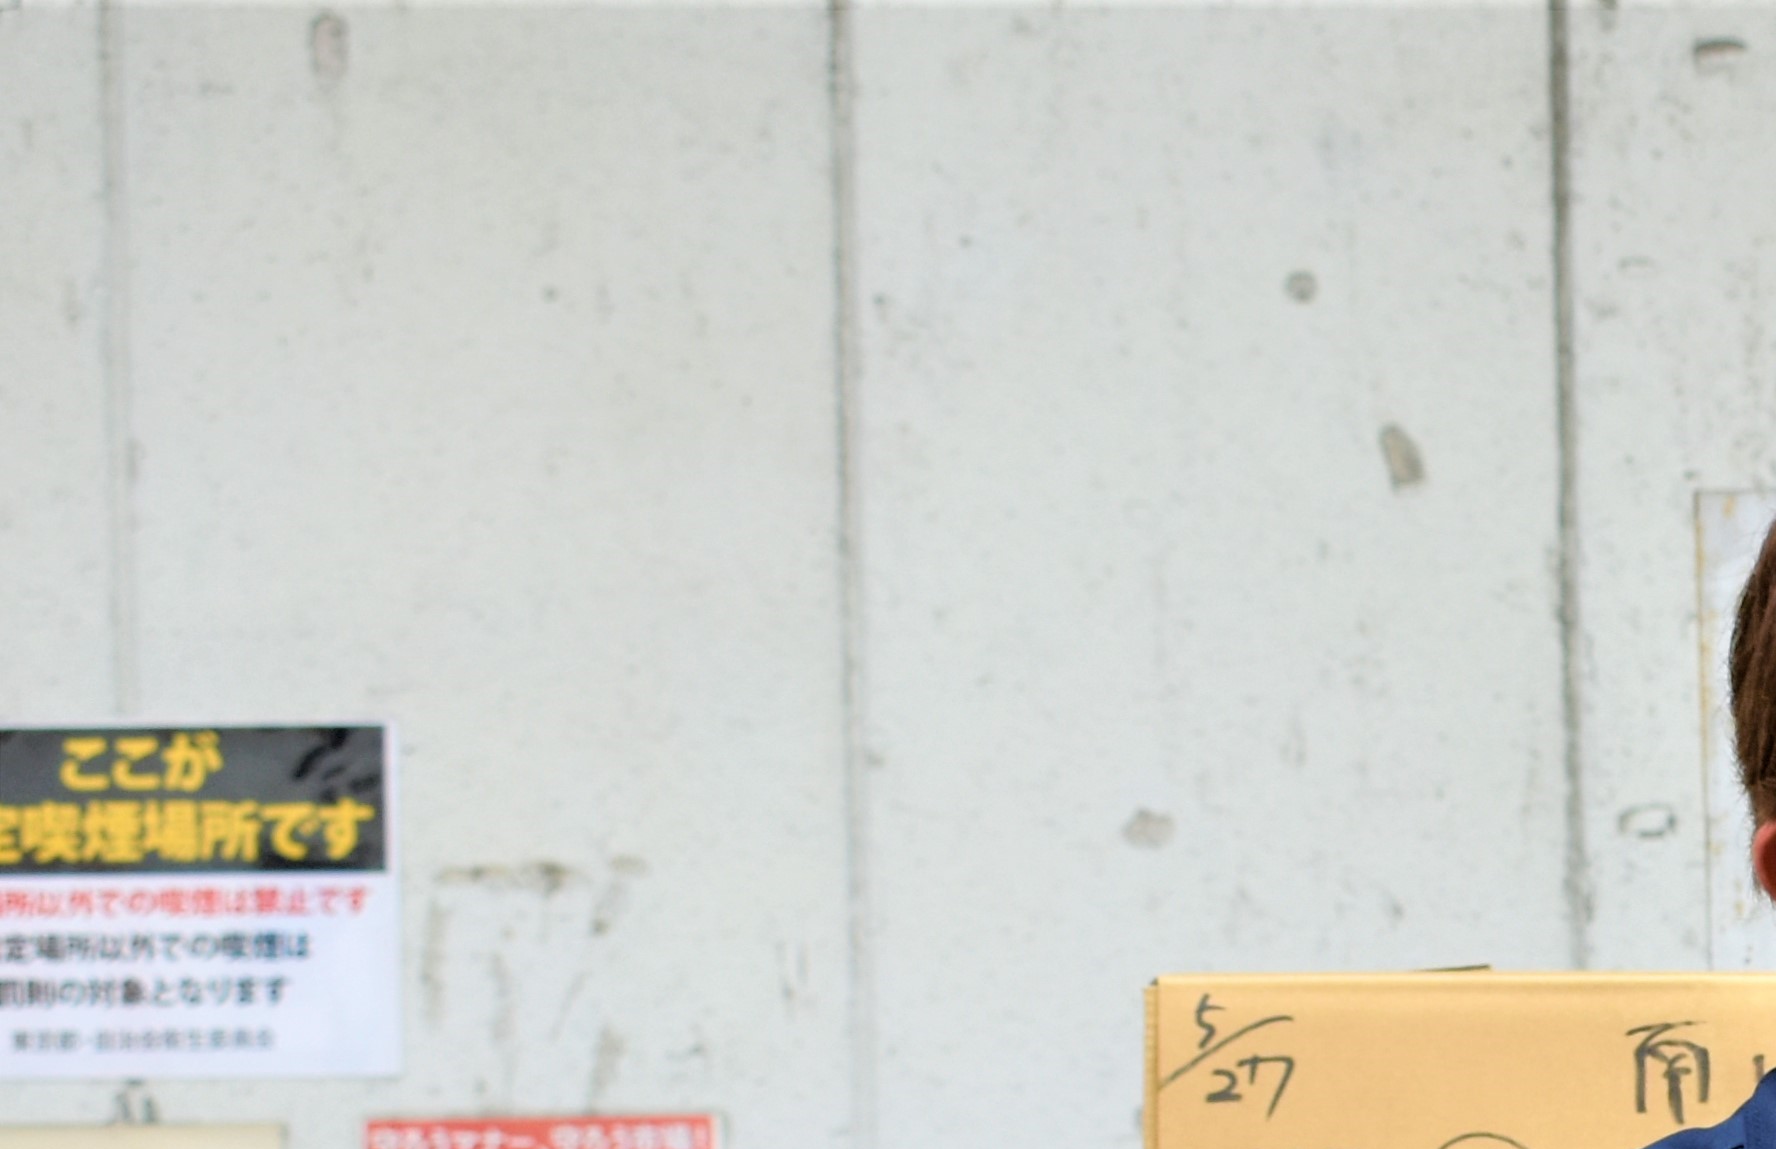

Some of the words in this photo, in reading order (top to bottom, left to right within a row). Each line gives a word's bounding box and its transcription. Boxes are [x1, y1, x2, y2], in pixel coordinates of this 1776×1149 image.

[60, 731, 224, 792] ここが
[0, 887, 368, 918] 所以外での喫煙は禁止です
[0, 932, 311, 962] 定場所以外での喫煙は
